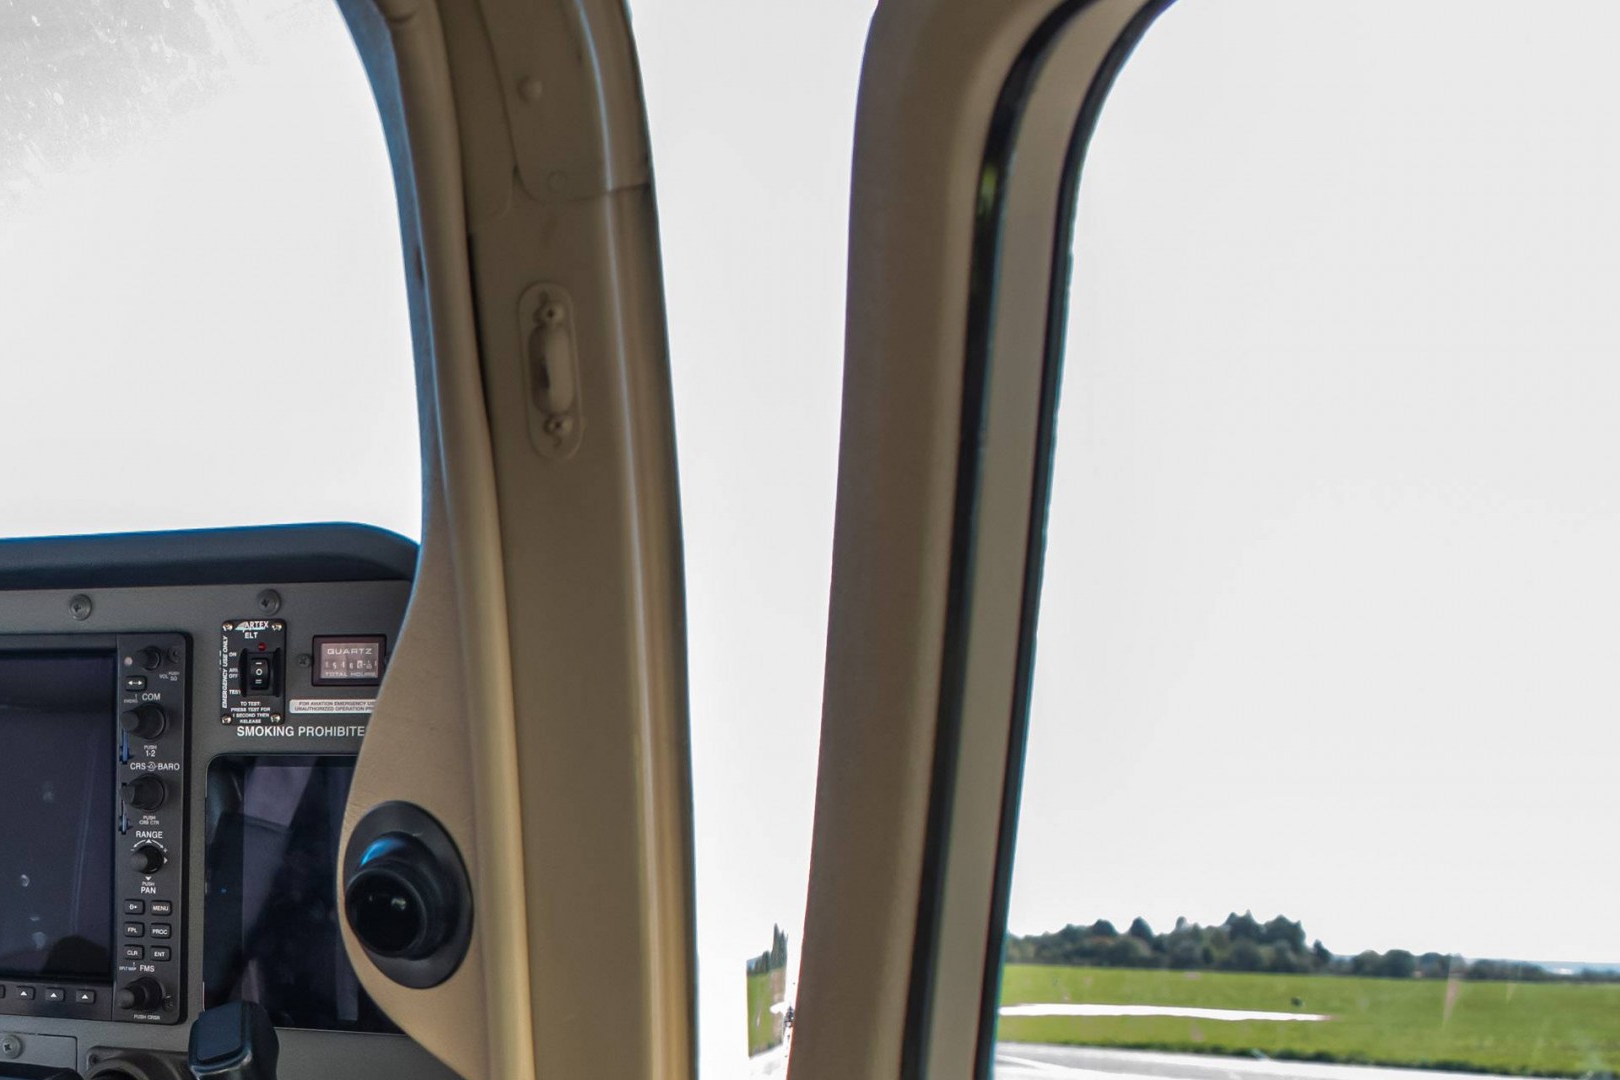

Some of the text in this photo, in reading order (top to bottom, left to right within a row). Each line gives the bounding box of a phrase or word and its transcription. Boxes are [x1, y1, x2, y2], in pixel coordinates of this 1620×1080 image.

[244, 620, 269, 628] ARTEX
[141, 693, 161, 701] COM
[236, 725, 366, 737] SMOKING PROHIBITE
[129, 762, 146, 771] CRS
[157, 762, 180, 771] BARO
[135, 831, 163, 839] RANGE
[140, 886, 157, 894] PAN
[139, 964, 155, 972] FMS
